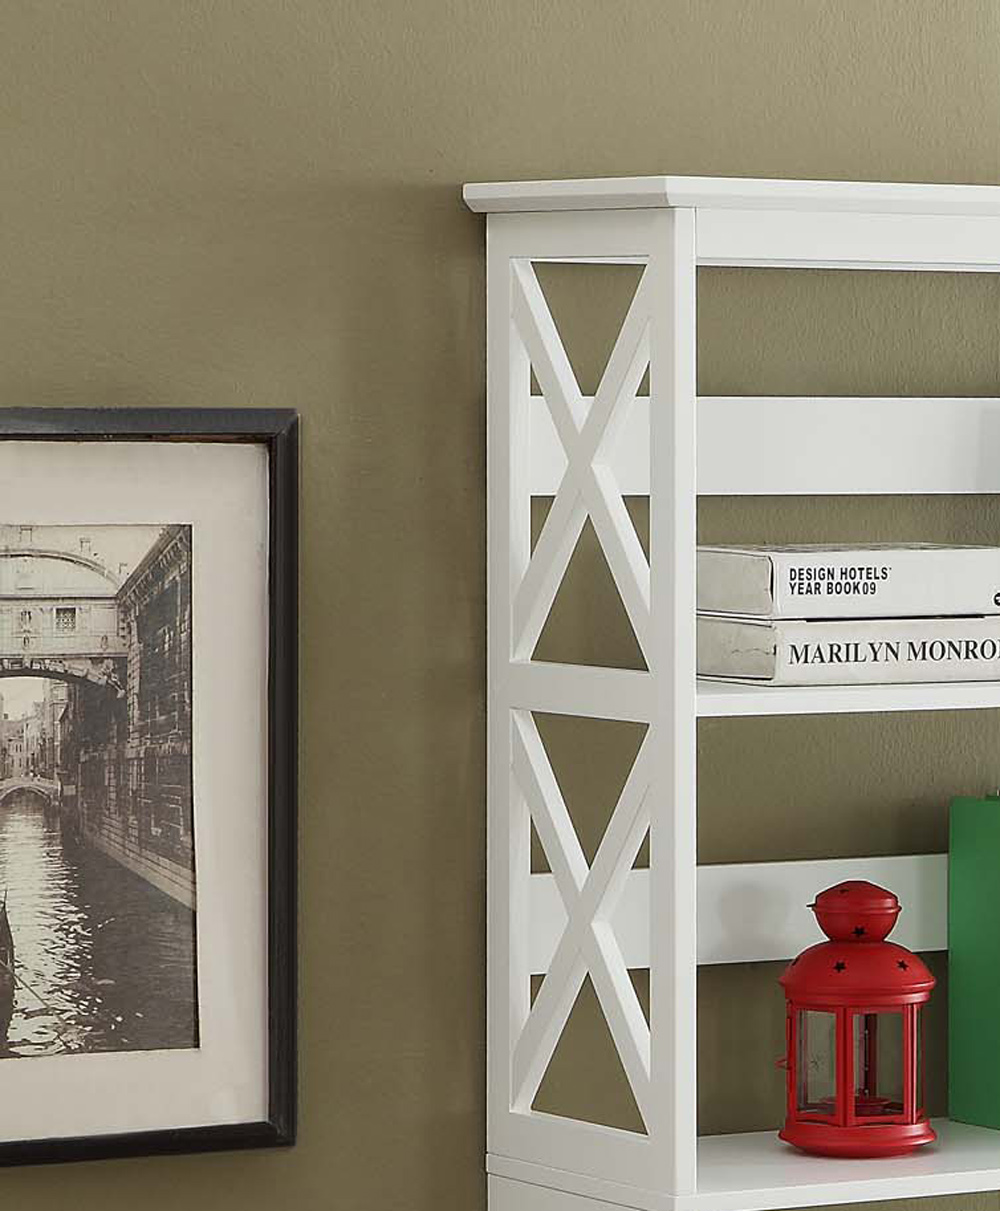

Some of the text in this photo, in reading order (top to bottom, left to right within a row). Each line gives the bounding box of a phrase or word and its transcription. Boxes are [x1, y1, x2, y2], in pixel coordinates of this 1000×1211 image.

[789, 568, 835, 581] DESIGN
[789, 582, 822, 595] YEAR
[789, 641, 900, 664] MARILYN
